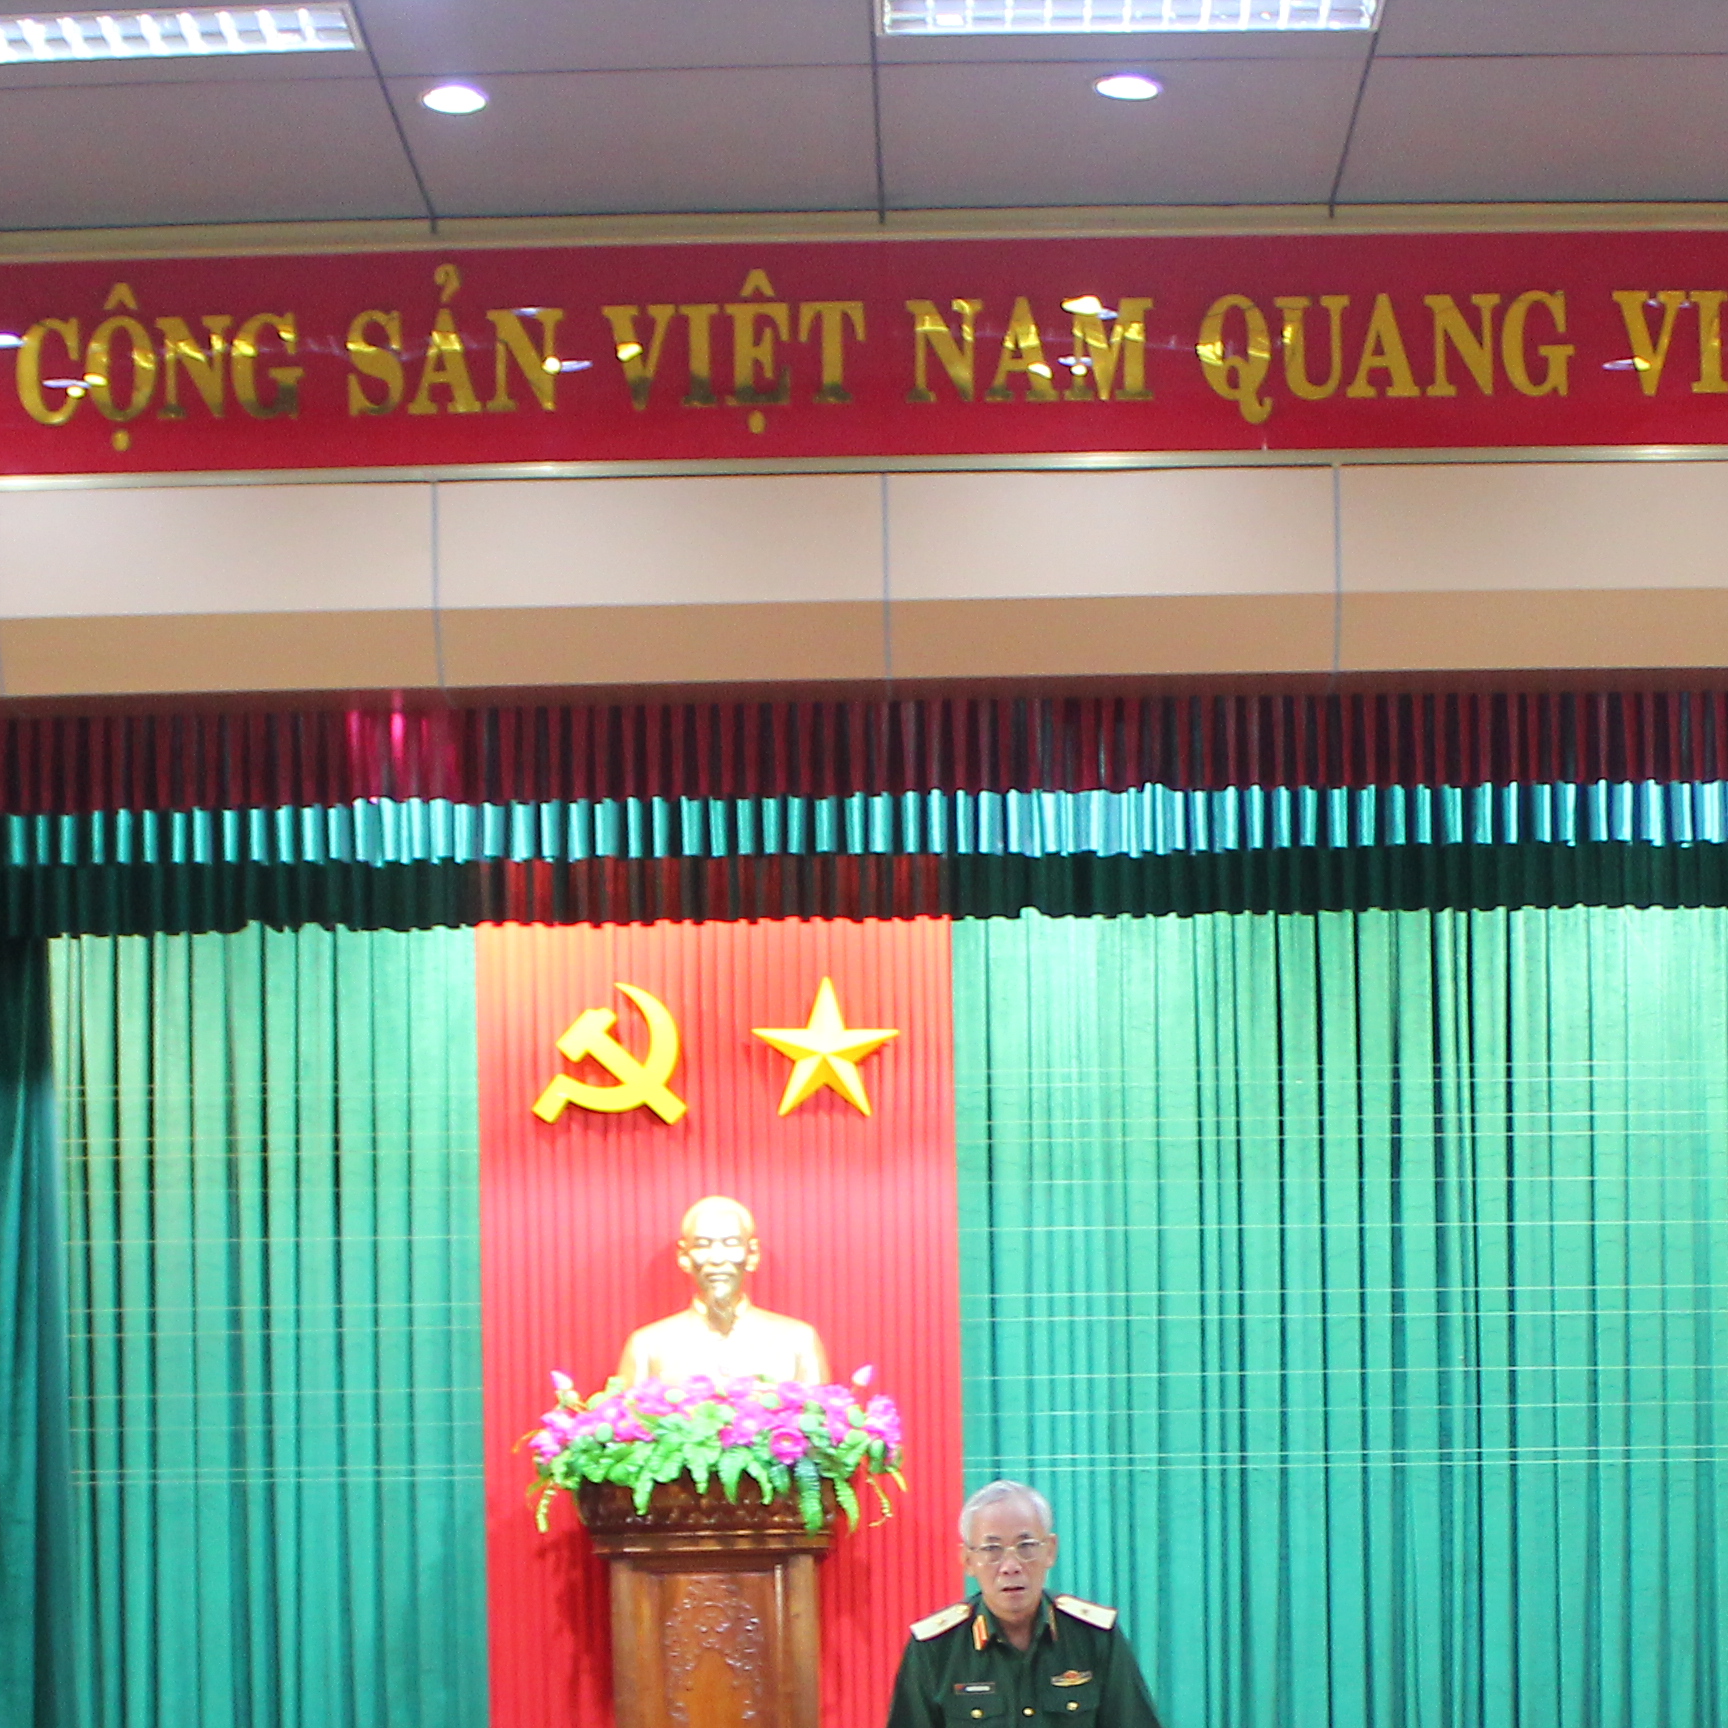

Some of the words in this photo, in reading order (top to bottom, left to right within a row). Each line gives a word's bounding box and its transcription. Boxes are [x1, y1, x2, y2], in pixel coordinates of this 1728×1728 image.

[16, 283, 301, 452] CỘNG
[345, 265, 561, 417] SẢN
[600, 269, 866, 435] VIỆT
[904, 294, 1158, 404] NAM
[1194, 288, 1571, 427] QUANG
